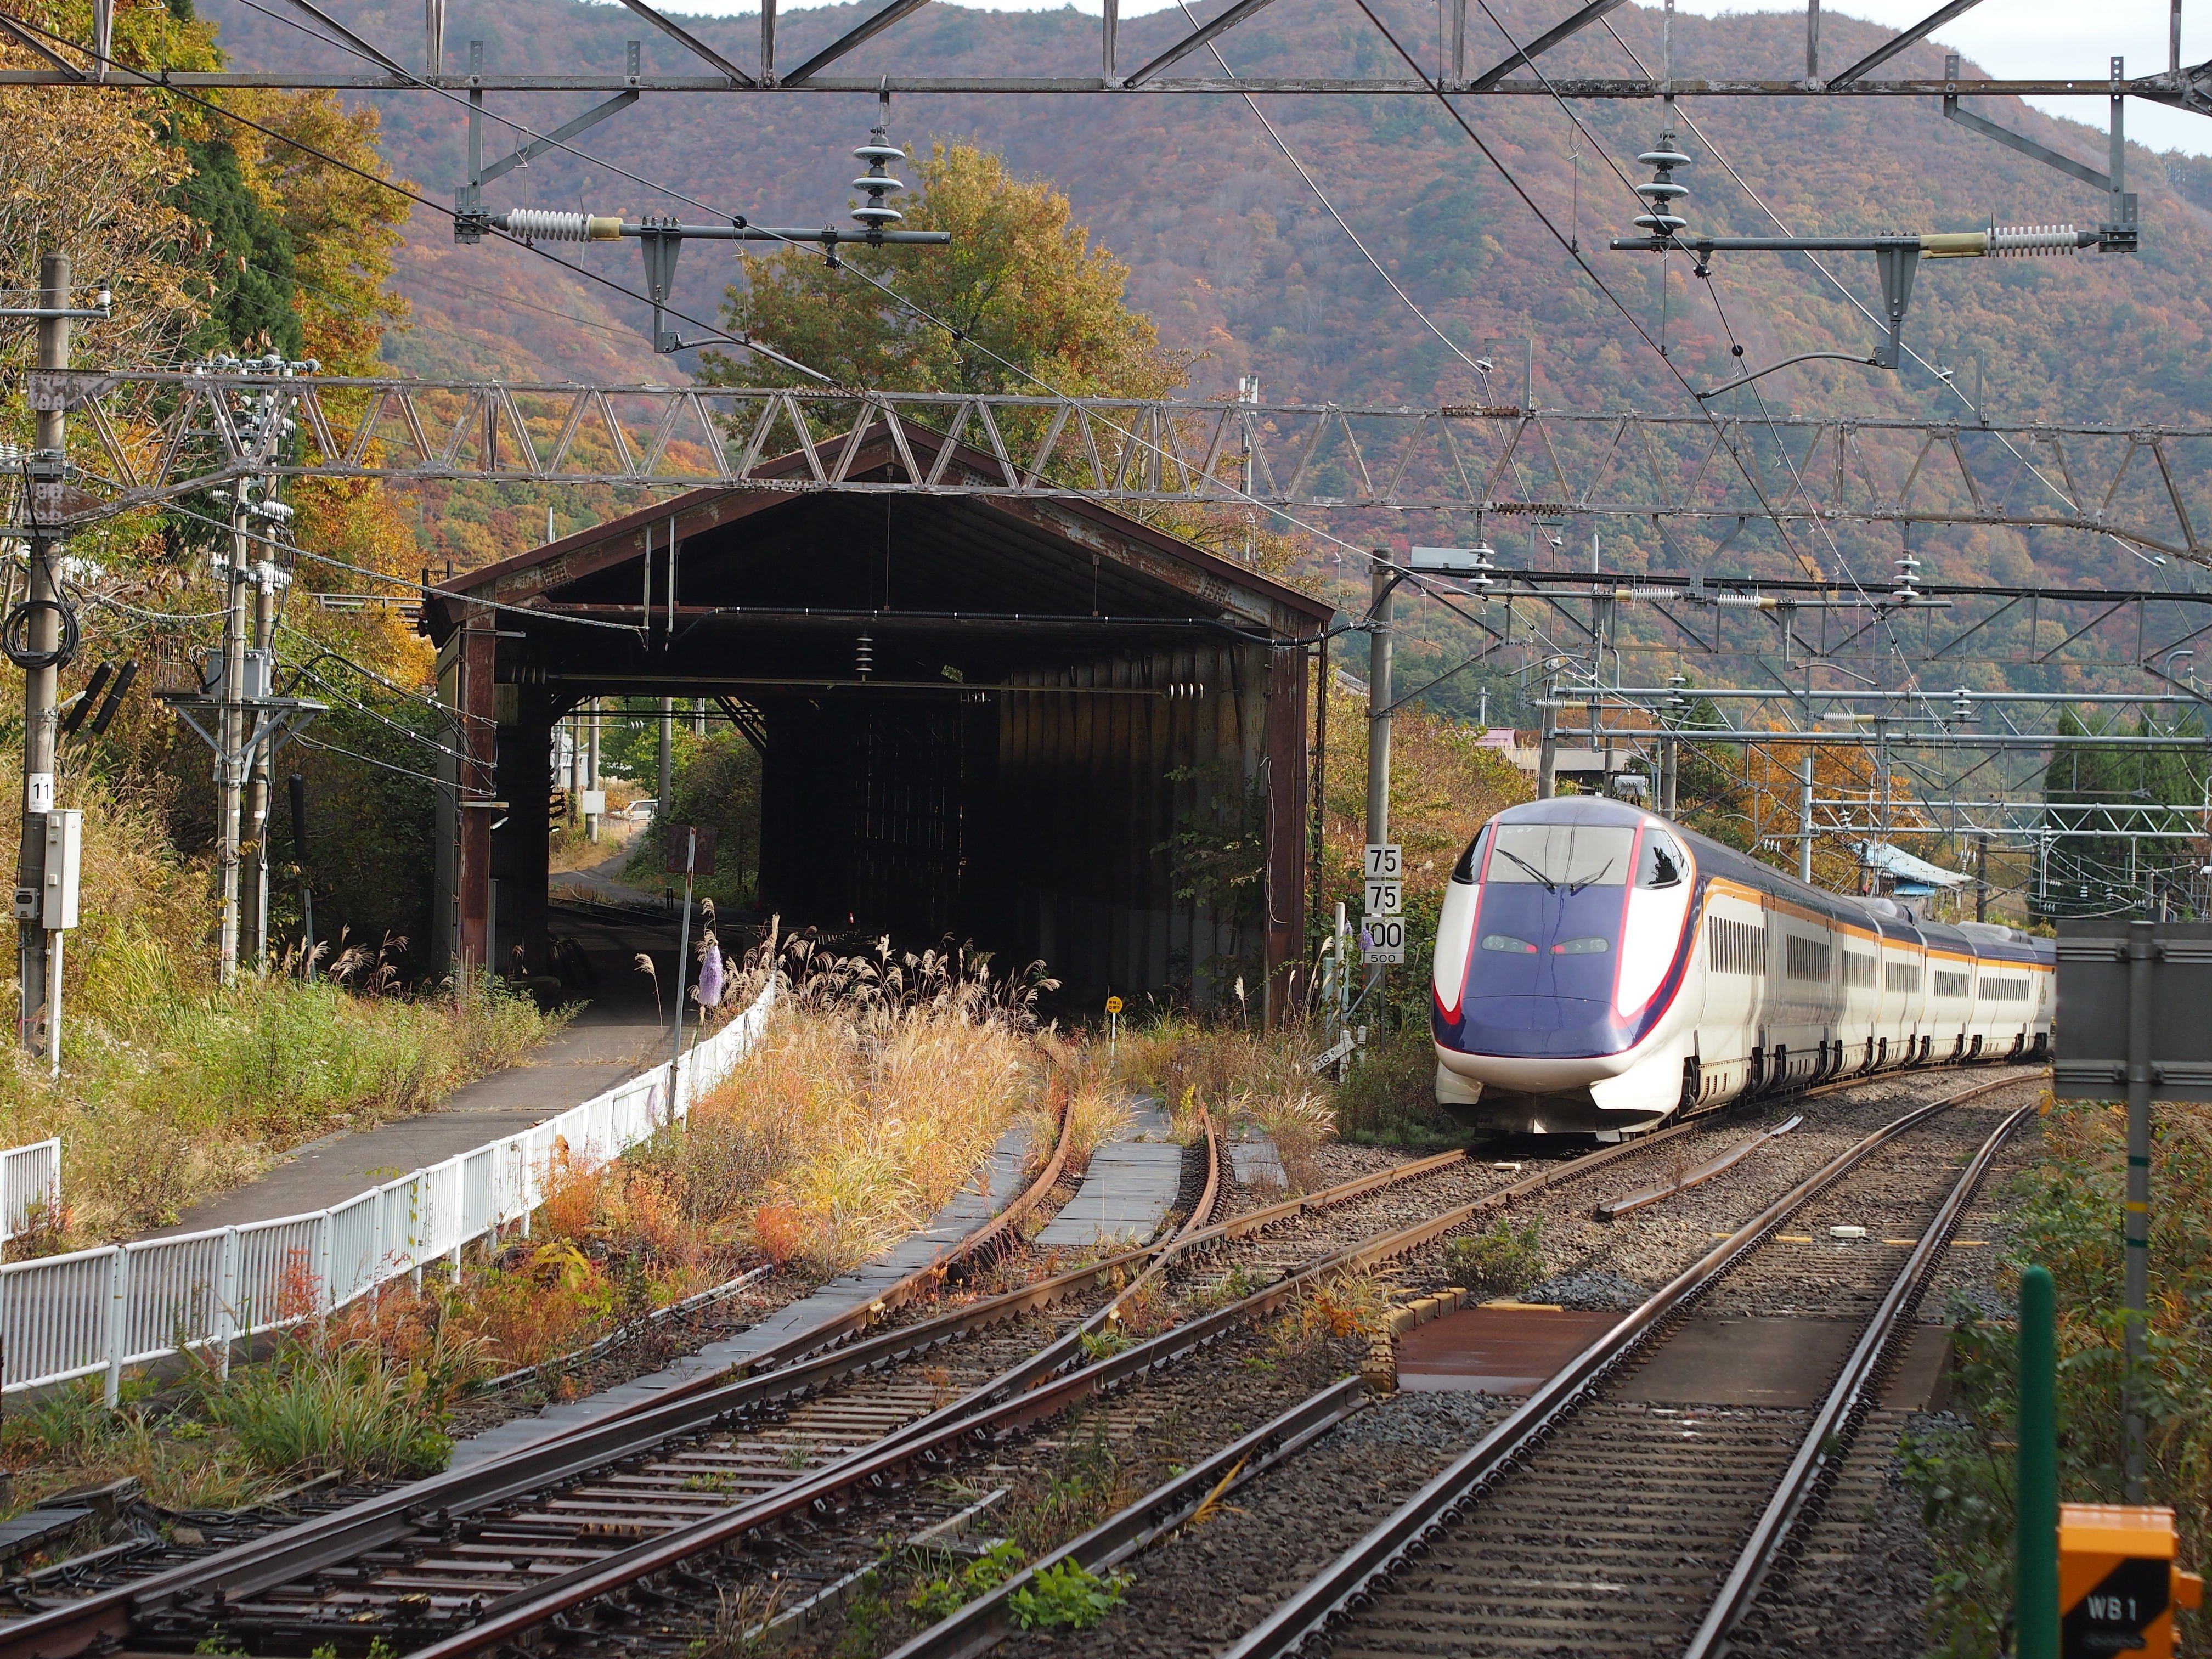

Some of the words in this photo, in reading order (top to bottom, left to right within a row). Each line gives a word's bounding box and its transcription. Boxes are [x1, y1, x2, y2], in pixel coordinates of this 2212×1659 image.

[33, 783, 48, 799] 11
[1370, 850, 1396, 872] 75
[1370, 886, 1396, 908] 75
